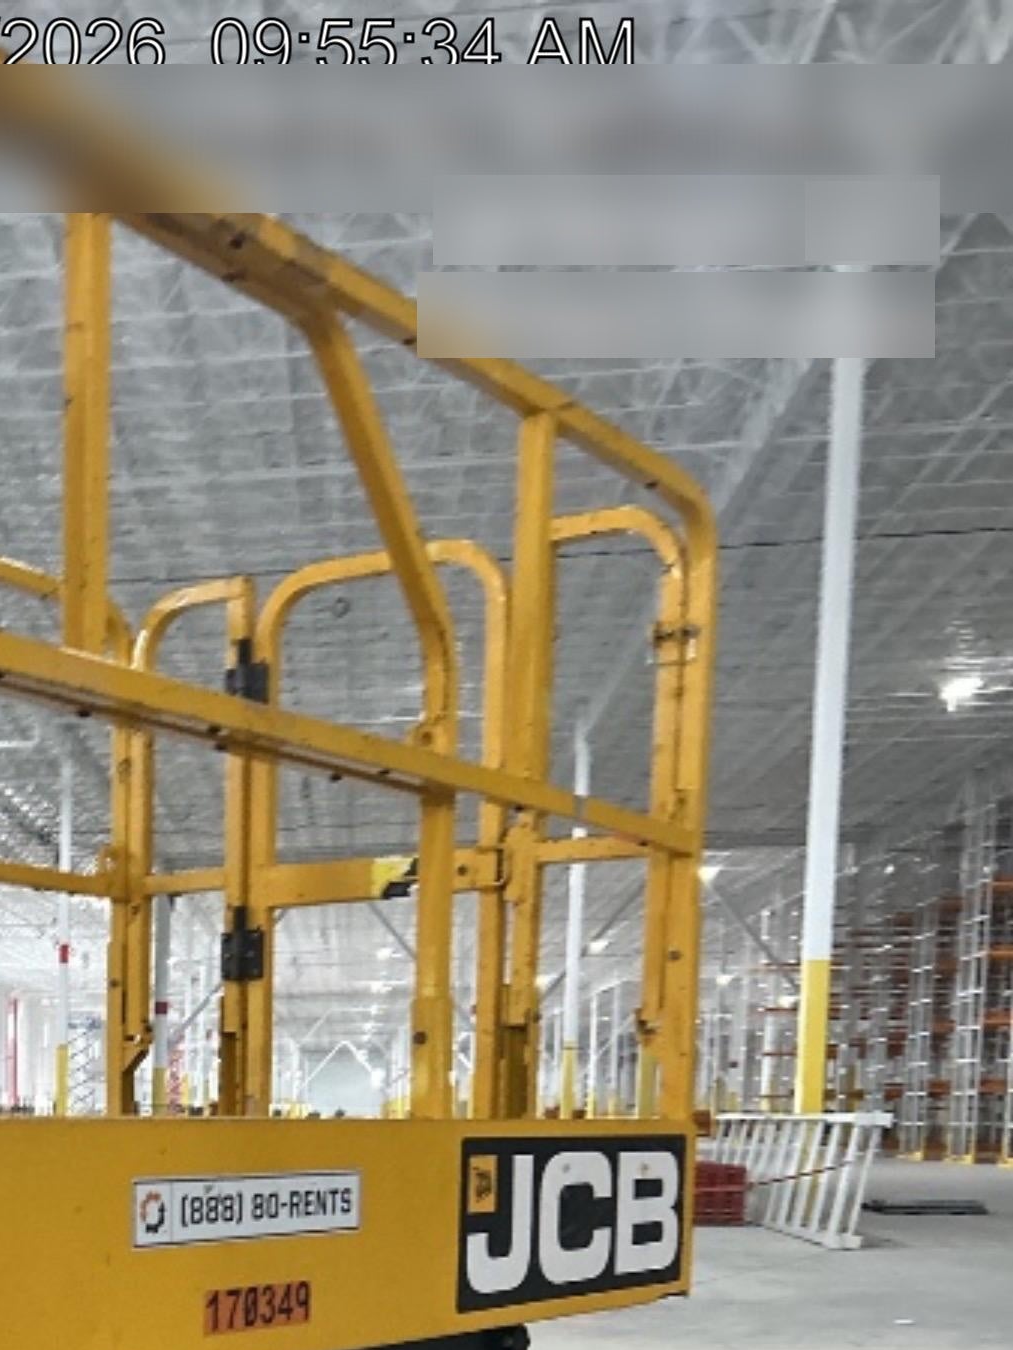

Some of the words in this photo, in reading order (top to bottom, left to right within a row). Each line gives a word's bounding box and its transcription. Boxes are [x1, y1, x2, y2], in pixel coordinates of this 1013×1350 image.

[181, 1191, 243, 1228] (888)
[251, 1187, 353, 1220] 80-RENTS
[466, 1151, 679, 1294] JCB
[205, 1281, 312, 1334] 170349
